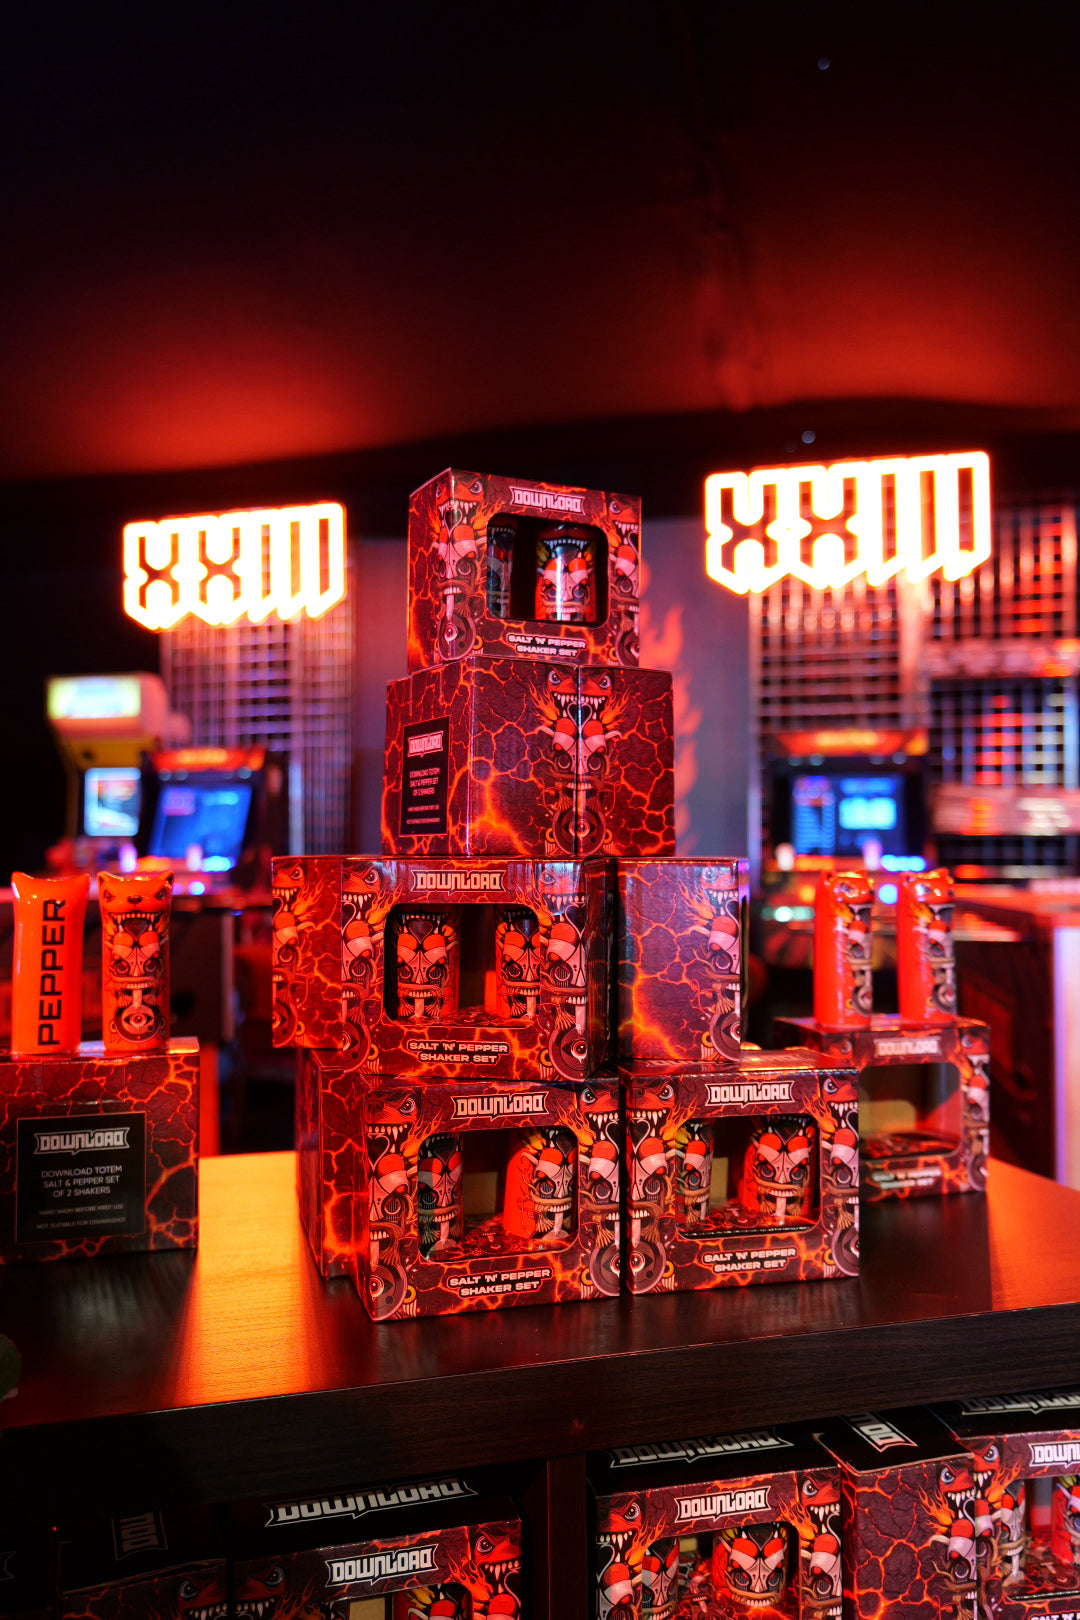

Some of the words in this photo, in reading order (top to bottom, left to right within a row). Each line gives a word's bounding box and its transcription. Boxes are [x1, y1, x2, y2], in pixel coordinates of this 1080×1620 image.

[513, 489, 583, 514] DOWNLOAD
[508, 635, 533, 644] SALT
[548, 638, 586, 649] PEPPER
[516, 645, 557, 655] SHAKER
[559, 649, 578, 657] SET
[415, 872, 503, 891] DOWNLOAD
[37, 898, 67, 1046] PEPPER
[409, 1042, 440, 1051] SALT
[458, 1043, 508, 1053] PEPPER
[420, 1053, 470, 1062] SHAKER
[472, 1054, 498, 1063] SET
[709, 1082, 791, 1104] DOWNLOAD
[455, 1093, 545, 1118] DOWNLOAD
[39, 1129, 125, 1152] DOWNLOAD
[41, 1167, 93, 1179] DOWNLOAD
[94, 1165, 123, 1175] TOTEM
[43, 1179, 63, 1189] SALT
[73, 1176, 104, 1187] PEPPER
[105, 1175, 121, 1184] SET
[53, 1189, 65, 1198] OF
[66, 1189, 72, 1197] 2
[73, 1186, 111, 1197] SHAKERS
[703, 1252, 734, 1263] SALT
[750, 1247, 797, 1259] PEPPER
[713, 1260, 761, 1273] SHAKER
[763, 1259, 787, 1269] SET
[449, 1275, 481, 1287] SALT
[500, 1268, 551, 1282] PEPPER
[460, 1283, 512, 1297] SHAKER
[514, 1280, 540, 1292] SET
[618, 1429, 781, 1465] DOWNLOAD
[276, 1476, 467, 1523] DOWNLOAD
[679, 1488, 768, 1518] DOWNLOAD
[330, 1548, 434, 1583] DOWNLOAD
